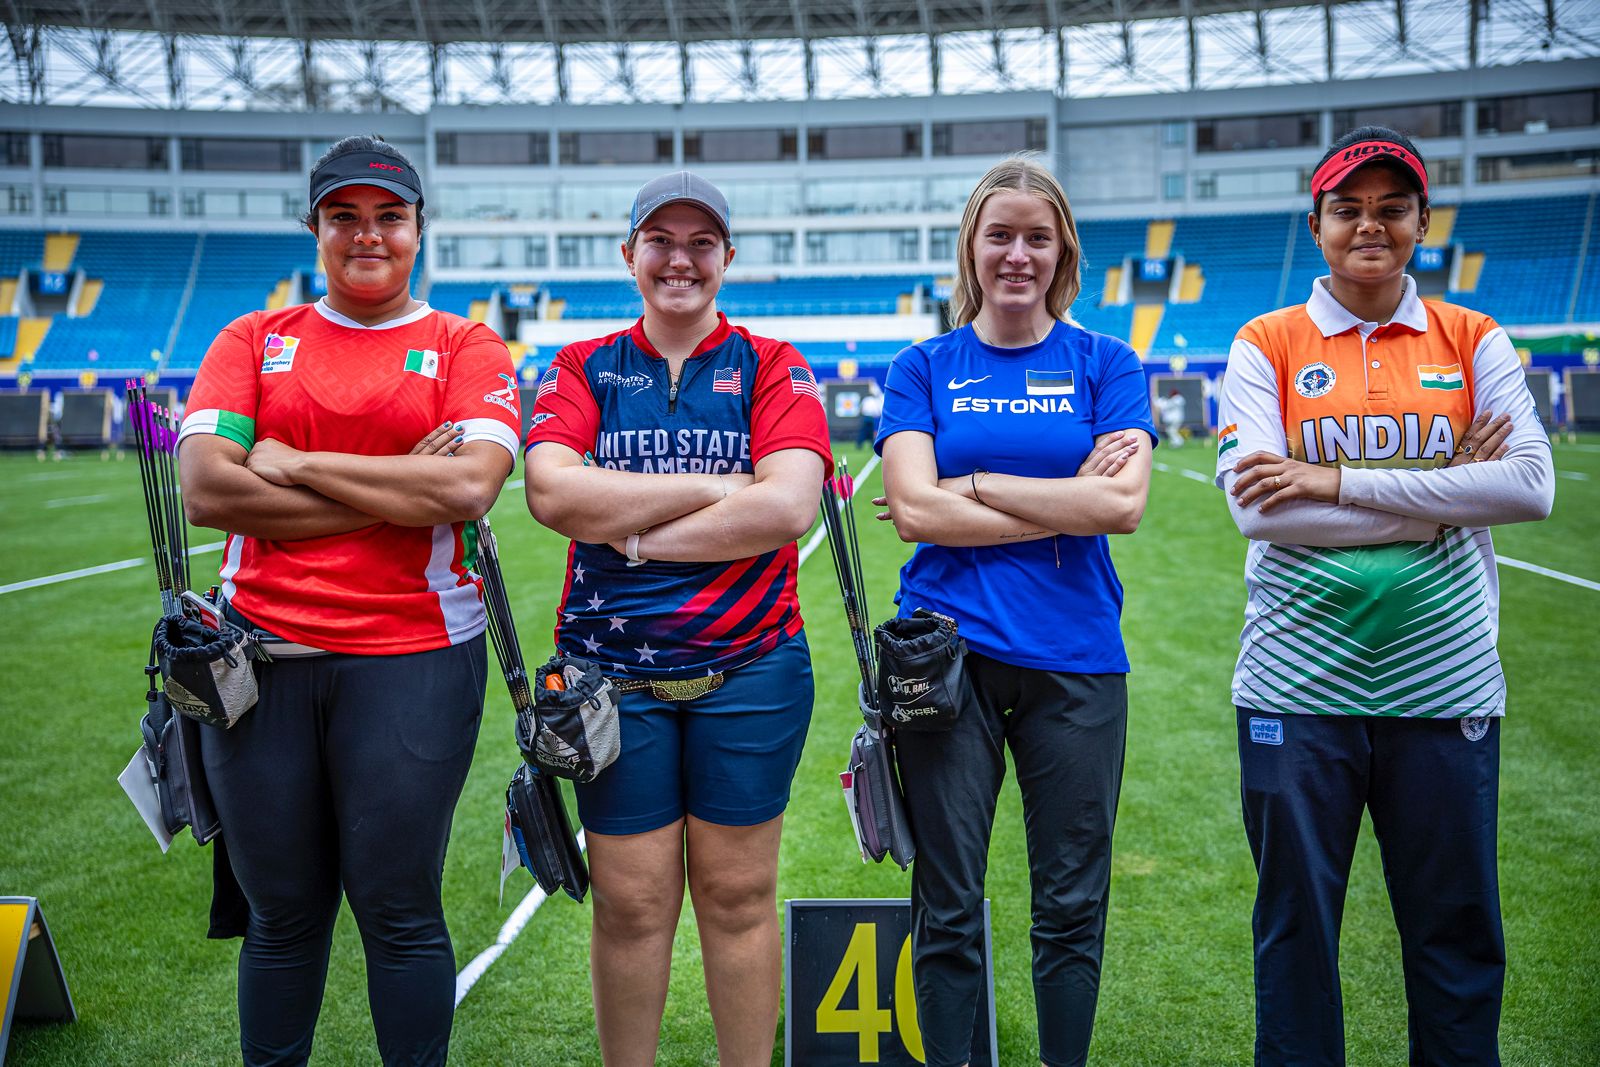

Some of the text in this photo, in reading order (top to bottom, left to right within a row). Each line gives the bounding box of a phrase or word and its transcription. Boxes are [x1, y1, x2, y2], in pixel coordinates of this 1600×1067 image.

[1343, 145, 1407, 161] HOYT
[369, 162, 403, 173] HOYT
[617, 374, 645, 384] STATES
[952, 397, 1075, 414] ESTONIA
[595, 429, 668, 457] NITED
[1301, 413, 1455, 464] INDIA
